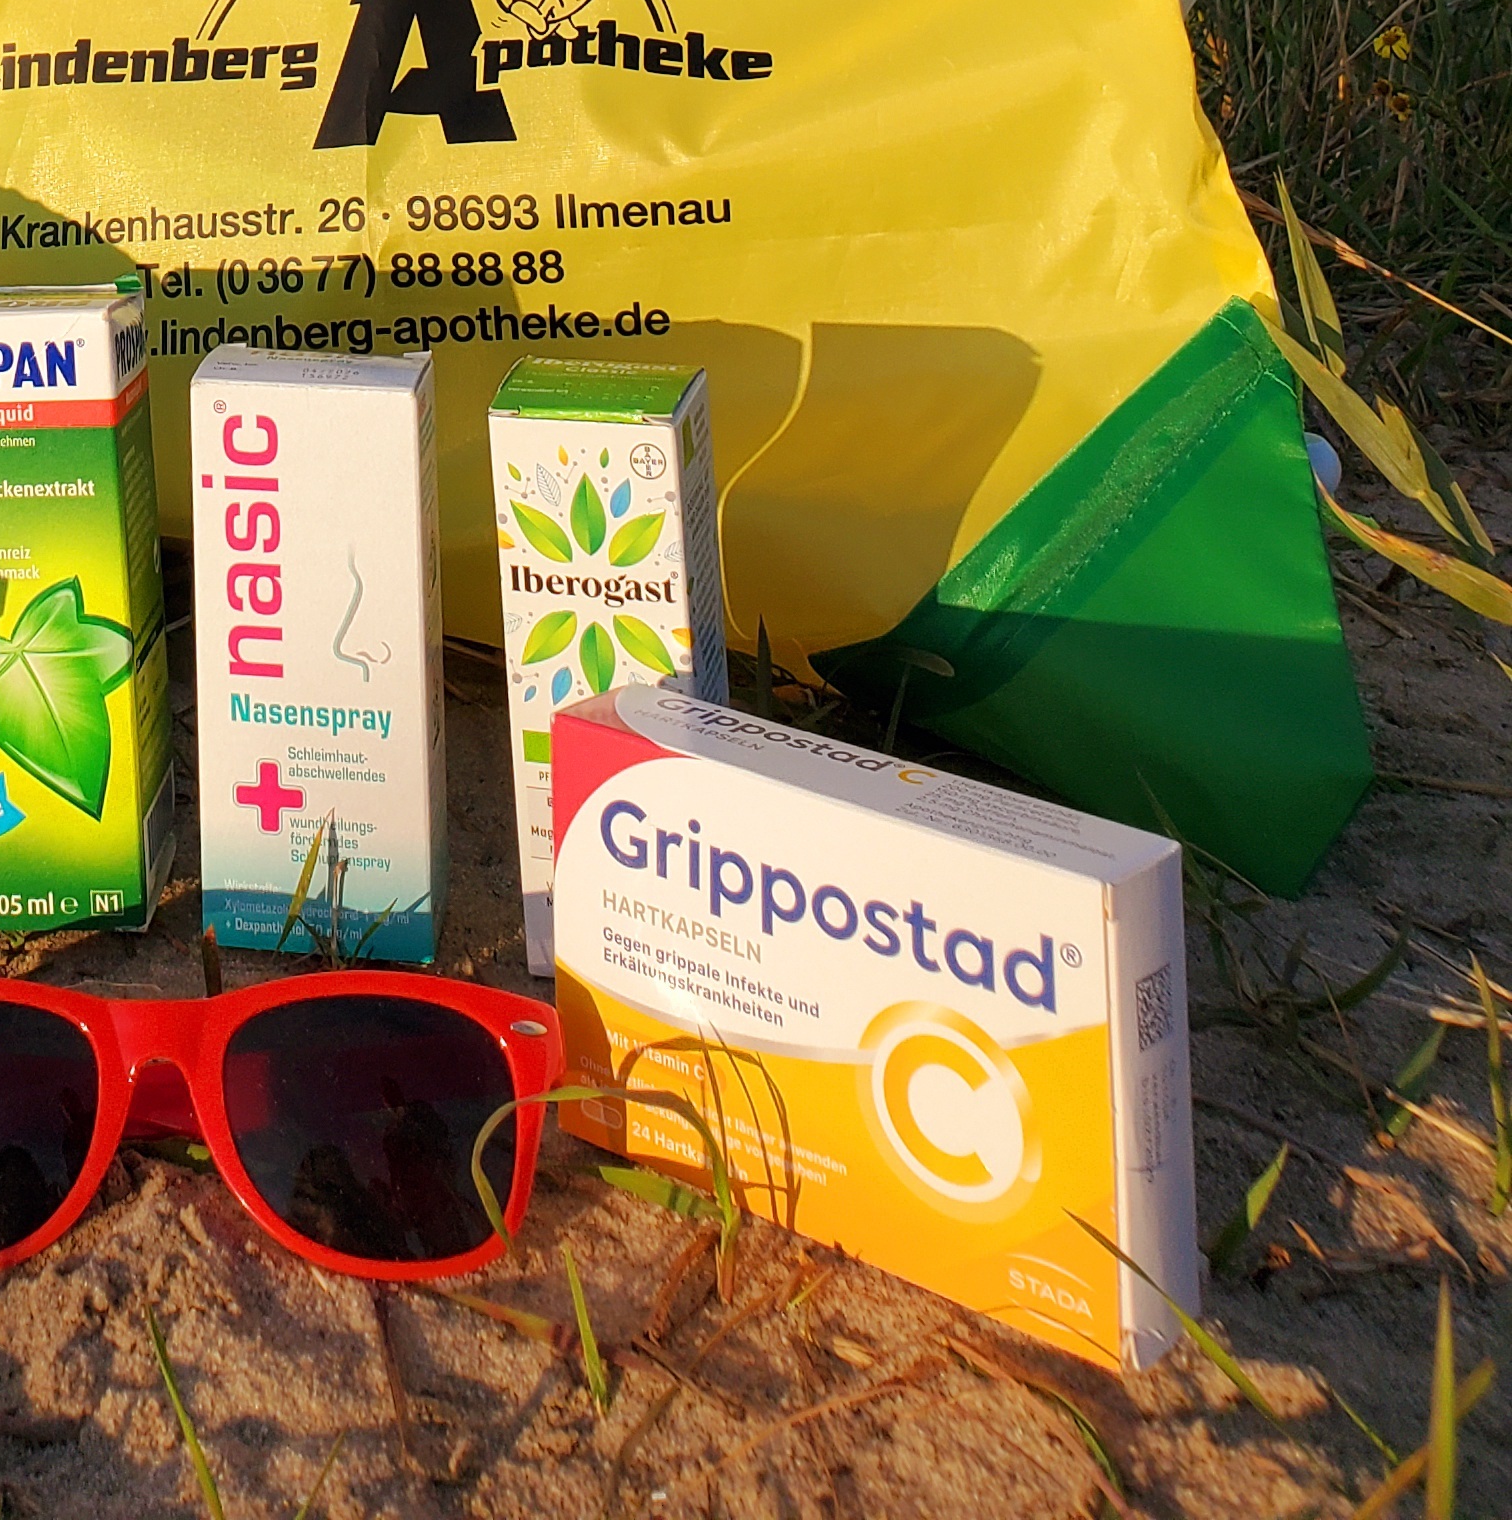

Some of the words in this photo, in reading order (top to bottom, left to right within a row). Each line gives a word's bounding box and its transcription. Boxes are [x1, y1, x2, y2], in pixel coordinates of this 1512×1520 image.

[1, 203, 302, 249] Krankenhausstr.
[318, 196, 366, 233] 26
[406, 194, 539, 231] 98693
[555, 193, 731, 229] Ilmenau
[136, 262, 203, 299] Tel.
[145, 301, 670, 355] .lindenberg-apotheke.de
[230, 692, 391, 739] Nasenspray
[634, 709, 765, 751] HARTKAPSELN
[288, 747, 369, 766] Schleimhaut-
[288, 766, 386, 783] abschwellendes
[897, 768, 937, 785] C
[291, 849, 391, 873] Scupnspray
[27, 891, 55, 915] ml
[94, 894, 120, 913] N1
[602, 888, 762, 964] HARTKAPSELN
[603, 926, 651, 956] Gegen
[655, 947, 721, 982] grippale
[725, 969, 784, 1005] Infekte
[788, 994, 820, 1019] und
[603, 947, 784, 1027] Erkältungskrankheiten
[606, 1029, 631, 1051] Mit
[633, 1037, 691, 1076] Vitamin
[693, 1063, 706, 1081] C
[874, 1024, 1016, 1198] C
[631, 1120, 651, 1141] 24
[654, 1129, 749, 1183] Hartkapln
[1008, 1268, 1094, 1320] STADA
